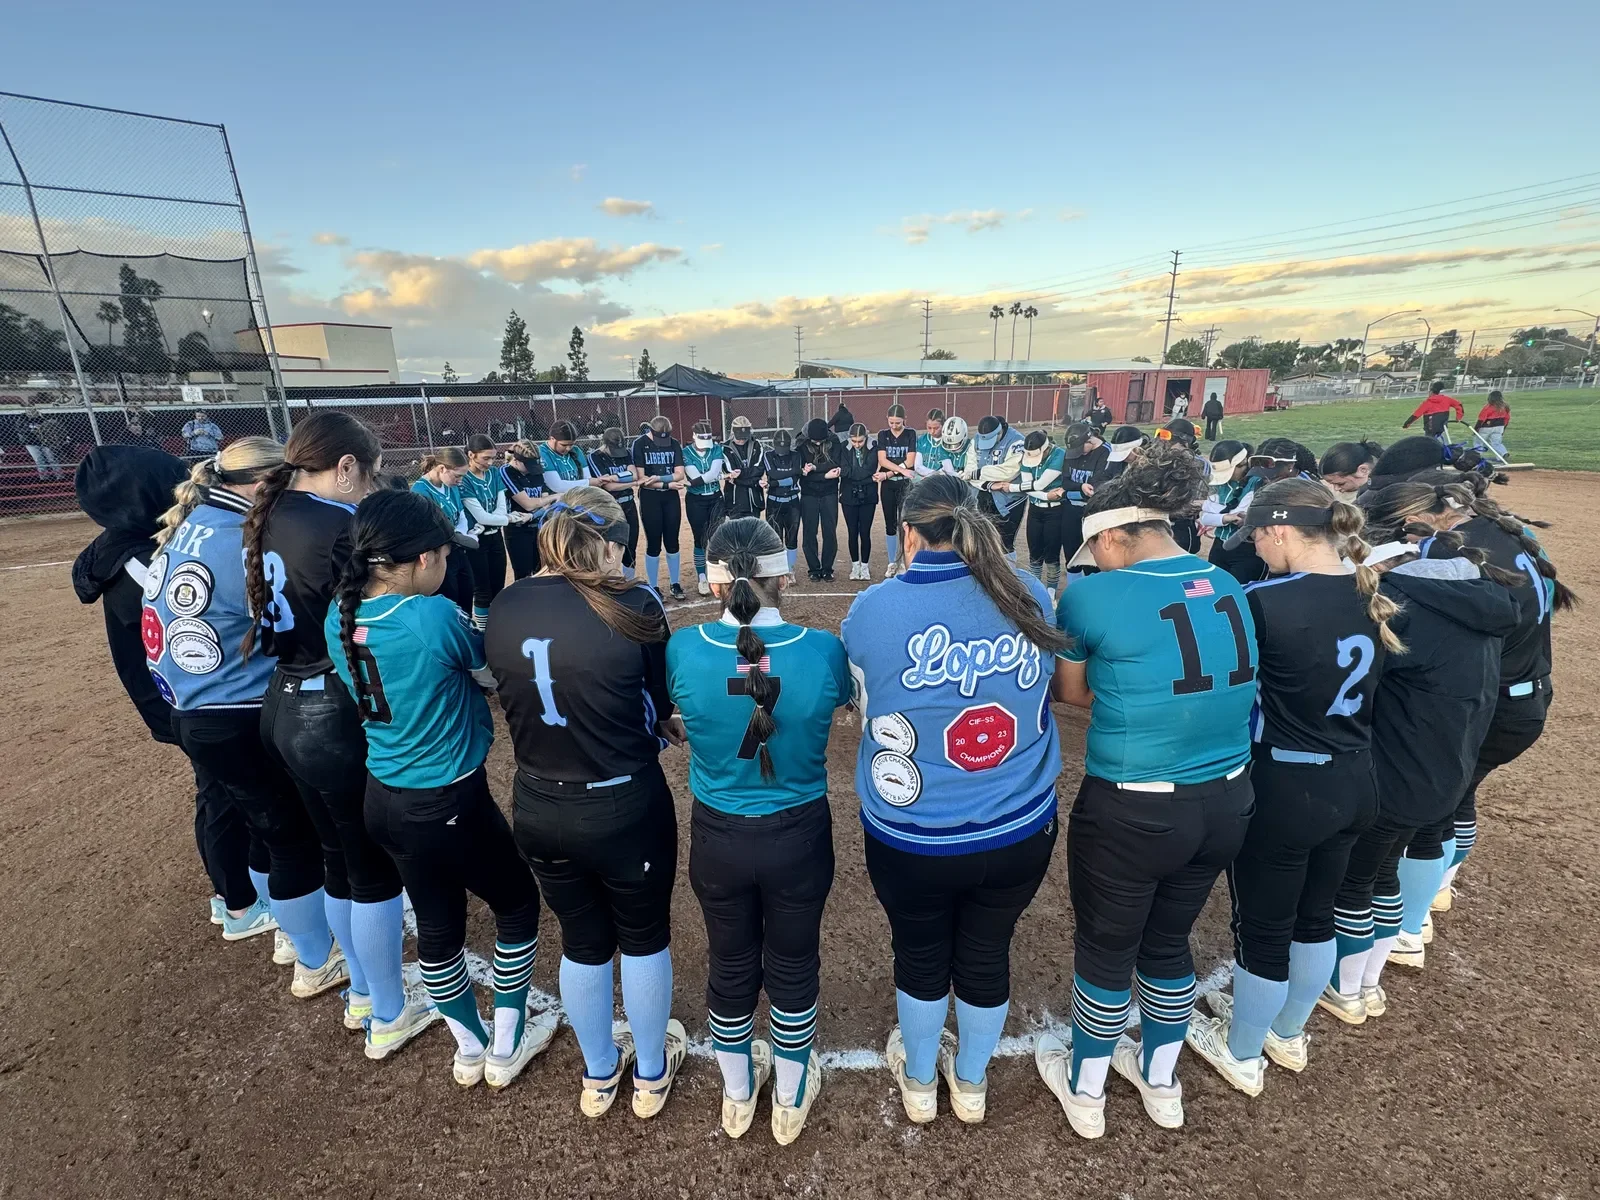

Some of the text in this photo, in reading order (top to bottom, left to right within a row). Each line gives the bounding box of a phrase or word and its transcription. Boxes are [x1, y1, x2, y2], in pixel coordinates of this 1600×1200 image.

[644, 451, 675, 465] LIBERTY
[166, 521, 214, 557] RK
[900, 623, 1043, 698] Lopez
[1158, 595, 1256, 696] 11
[522, 637, 567, 727] 1
[1326, 634, 1375, 717] 2
[727, 676, 781, 760] 7
[969, 716, 995, 726] CIF-SS
[955, 730, 1007, 746] 20 23
[960, 744, 1005, 763] CHAMPIONS
[888, 756, 916, 785] CHAMPIONS
